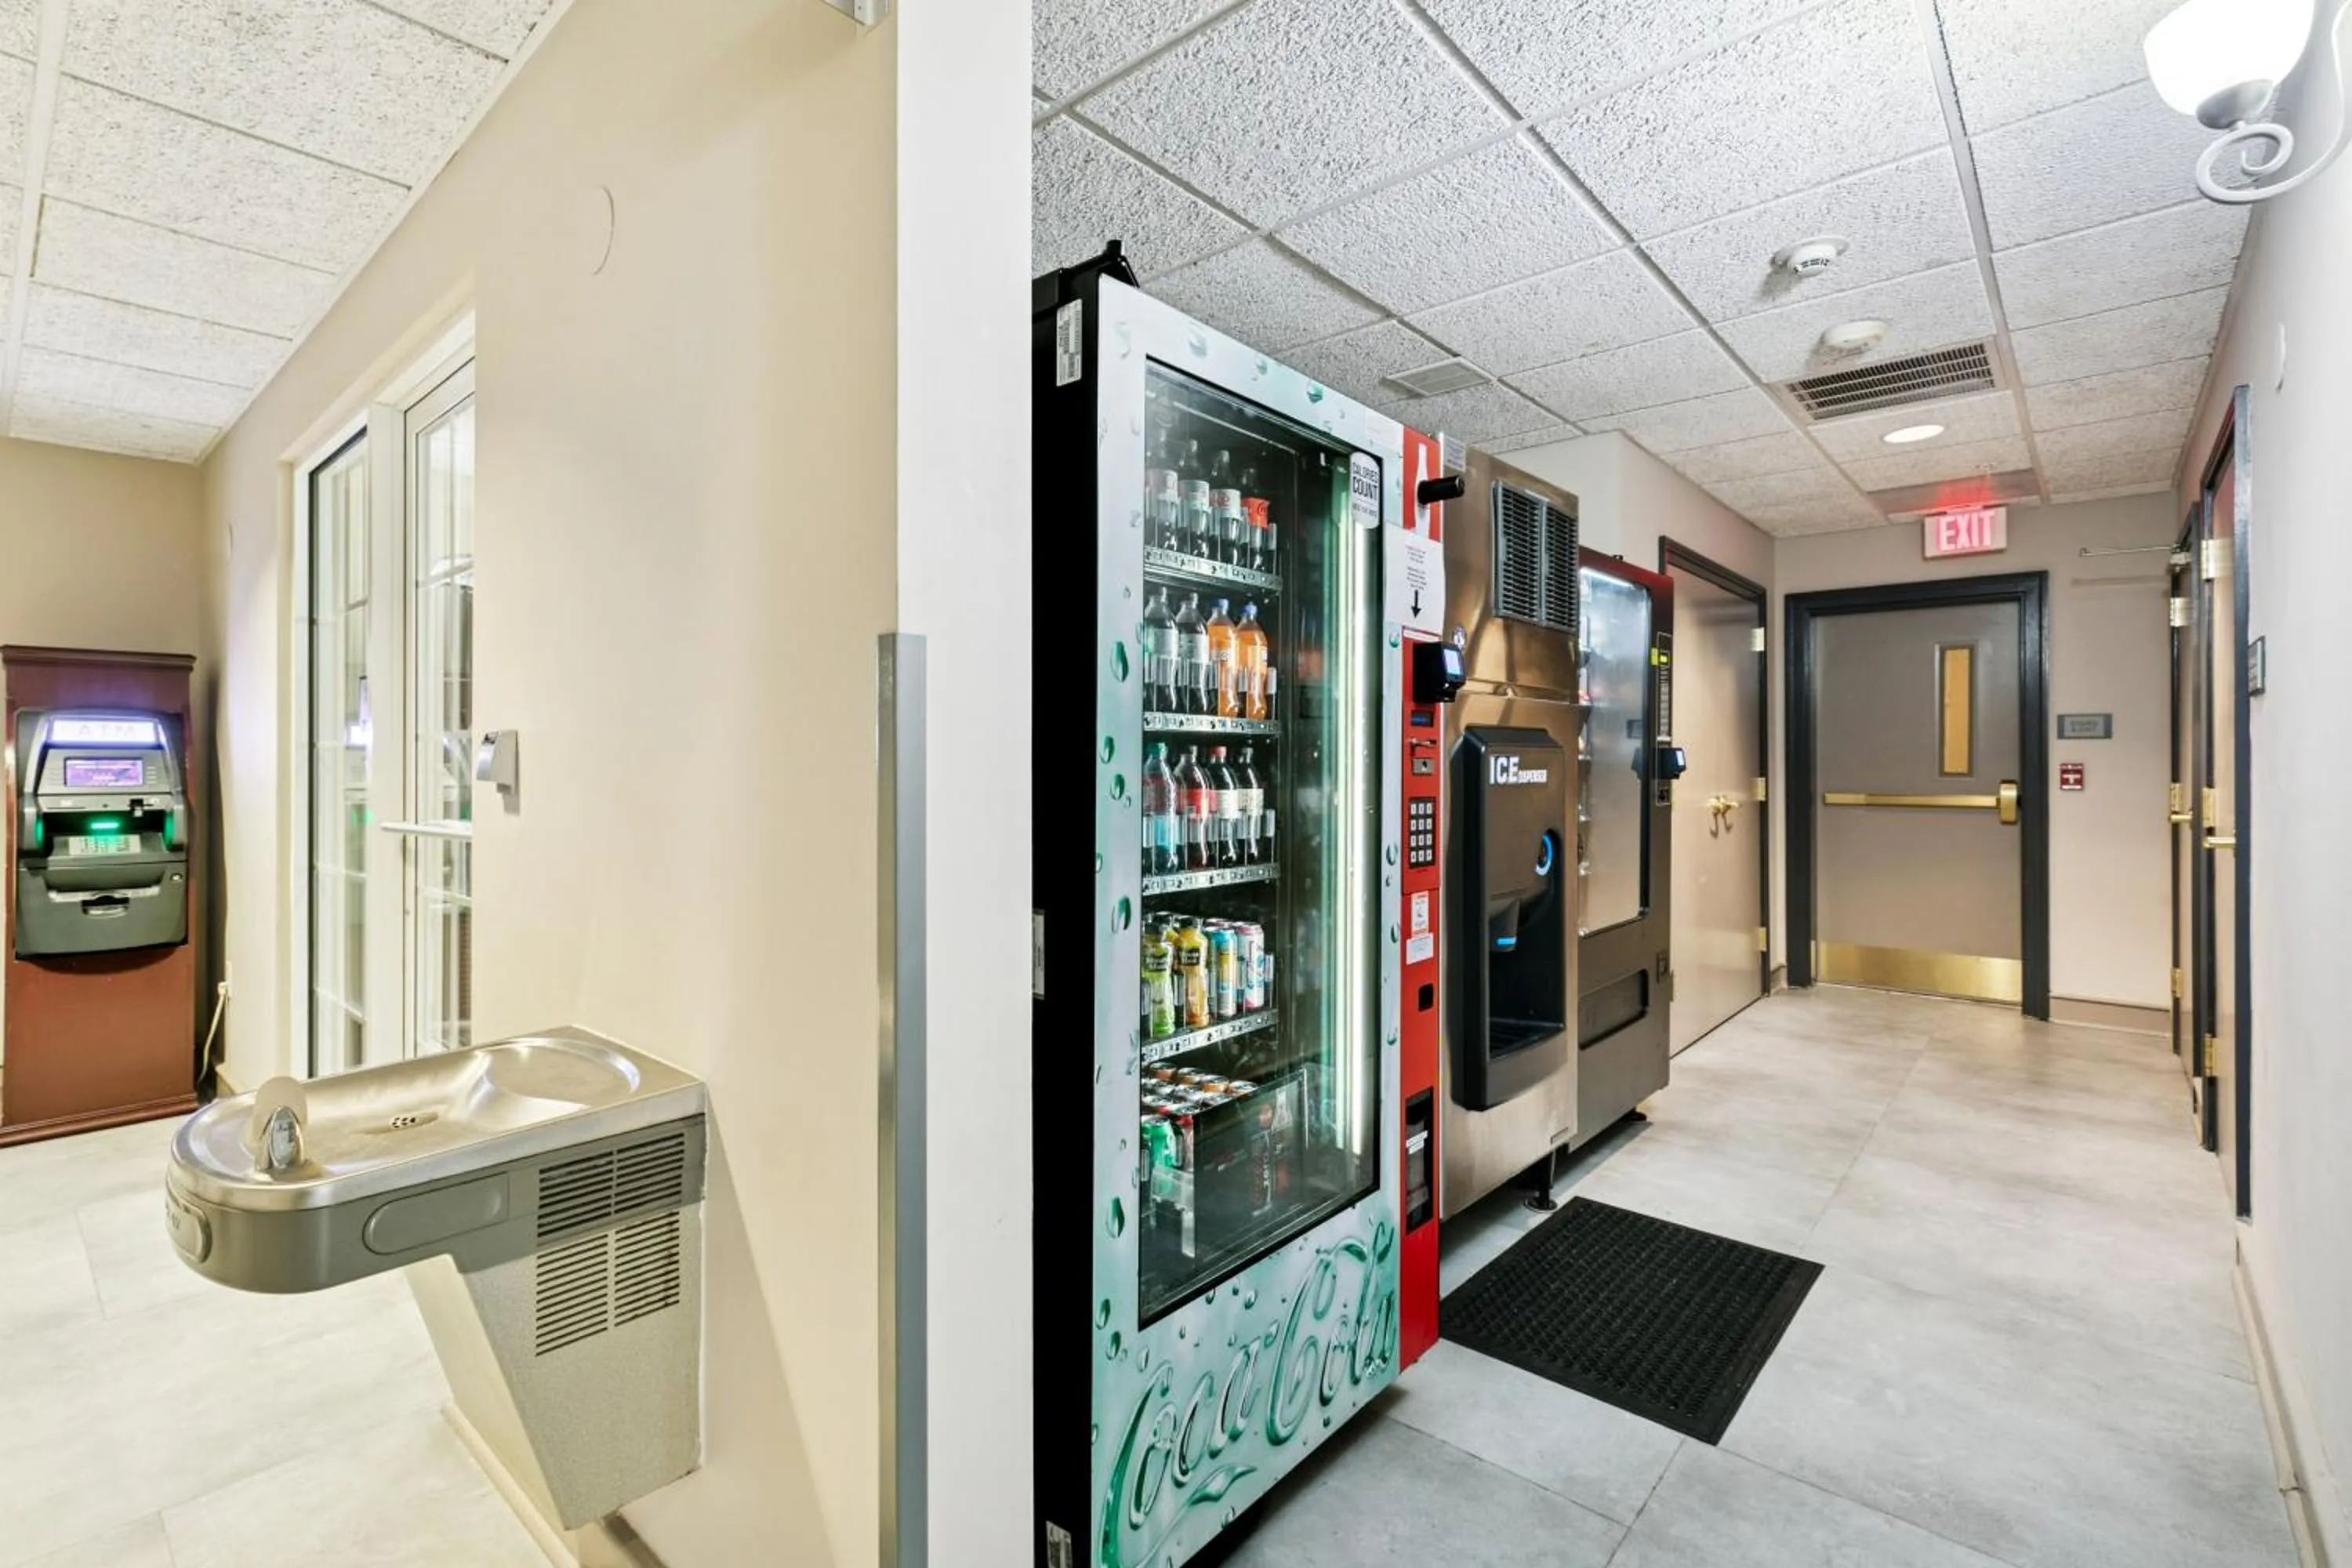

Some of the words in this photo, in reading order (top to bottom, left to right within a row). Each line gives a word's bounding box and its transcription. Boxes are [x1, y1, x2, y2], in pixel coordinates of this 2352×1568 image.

[1352, 476, 1377, 500] COUNT
[1939, 510, 1995, 551] EXIT
[1490, 756, 1519, 785] ICE
